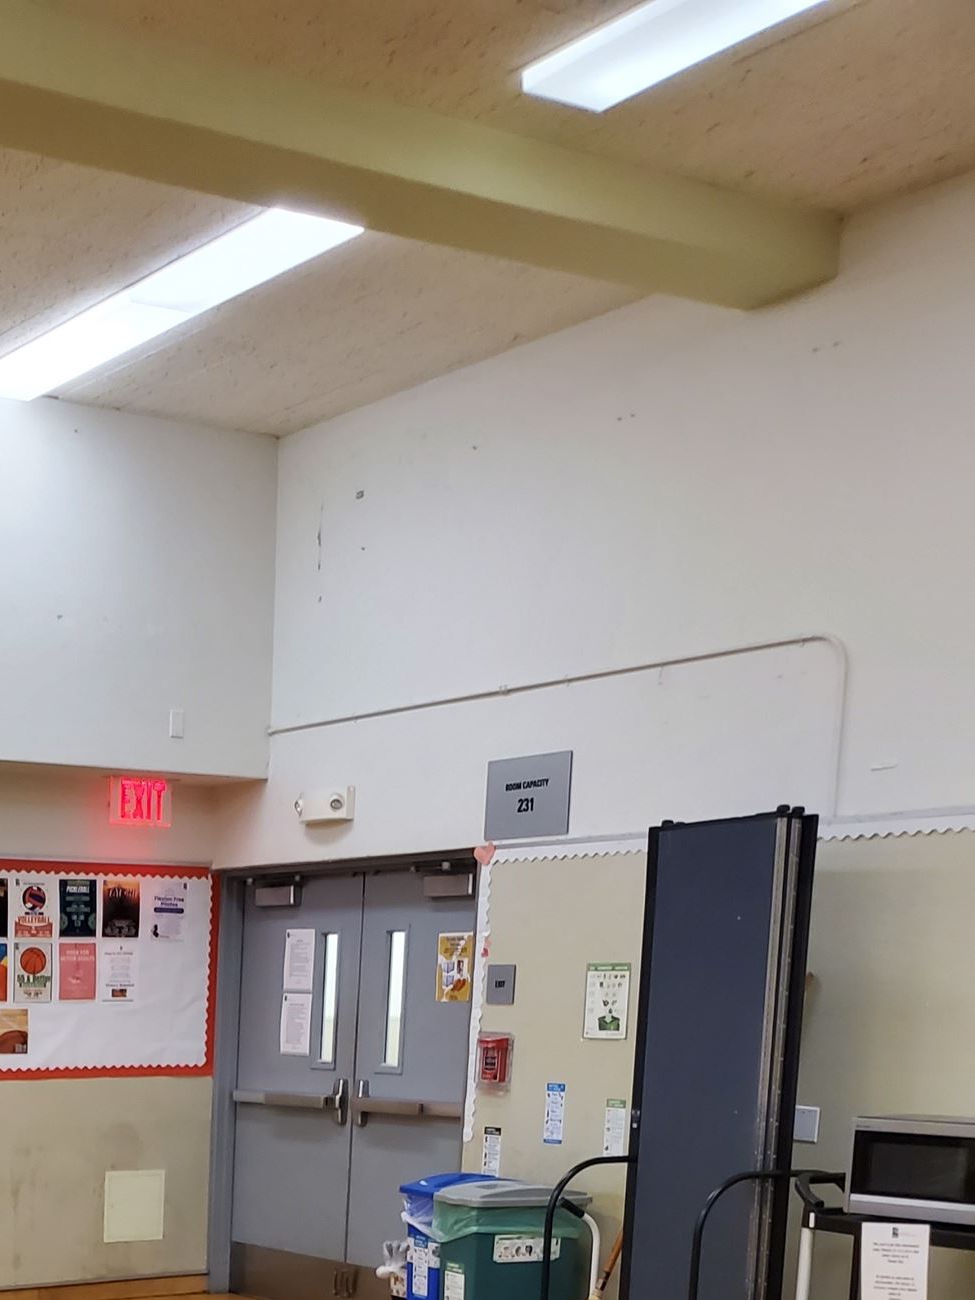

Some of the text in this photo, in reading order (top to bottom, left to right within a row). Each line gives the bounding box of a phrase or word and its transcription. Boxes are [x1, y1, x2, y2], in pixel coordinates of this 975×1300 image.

[505, 778, 550, 792] ROOM CAPACITY
[121, 778, 166, 821] EXIT
[516, 797, 534, 813] 231
[17, 915, 50, 924] VOLLEYBALL
